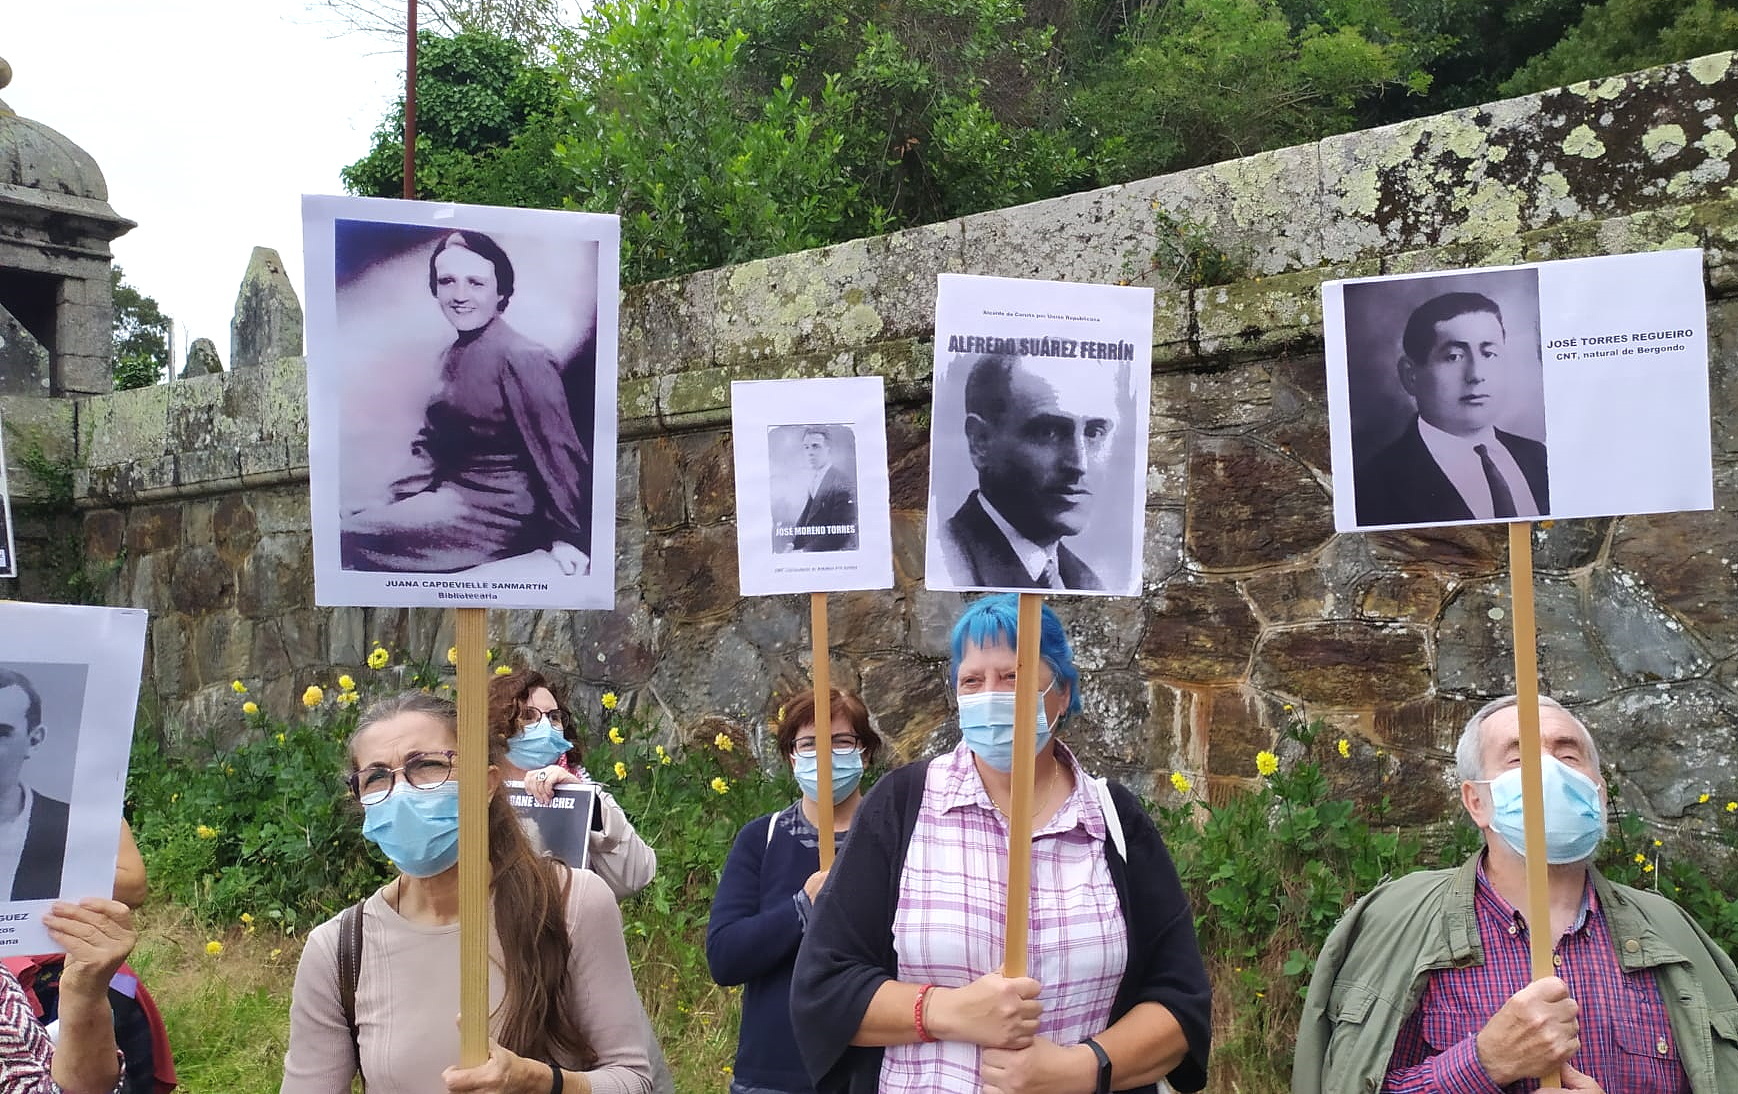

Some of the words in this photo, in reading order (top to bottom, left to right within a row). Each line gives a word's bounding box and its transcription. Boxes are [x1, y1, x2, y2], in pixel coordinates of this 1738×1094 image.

[1547, 337, 1577, 349] JOSÉ
[1581, 334, 1628, 346] TORRES
[1632, 329, 1693, 342] REGUEIRO
[948, 334, 1017, 355] ALFREDO
[1018, 336, 1078, 358] SUÁREZ
[1080, 339, 1135, 361] FERRÍN
[1556, 352, 1580, 361] CNT,
[1583, 348, 1618, 359] natural
[1622, 346, 1634, 355] de
[1637, 344, 1685, 355] Bergondo
[794, 526, 826, 536] MORENO
[826, 524, 856, 535] TORRES
[422, 581, 488, 589] CAPDEVIELLE
[438, 592, 498, 600] Bibliotecaria
[534, 797, 576, 809] SCHEZ
